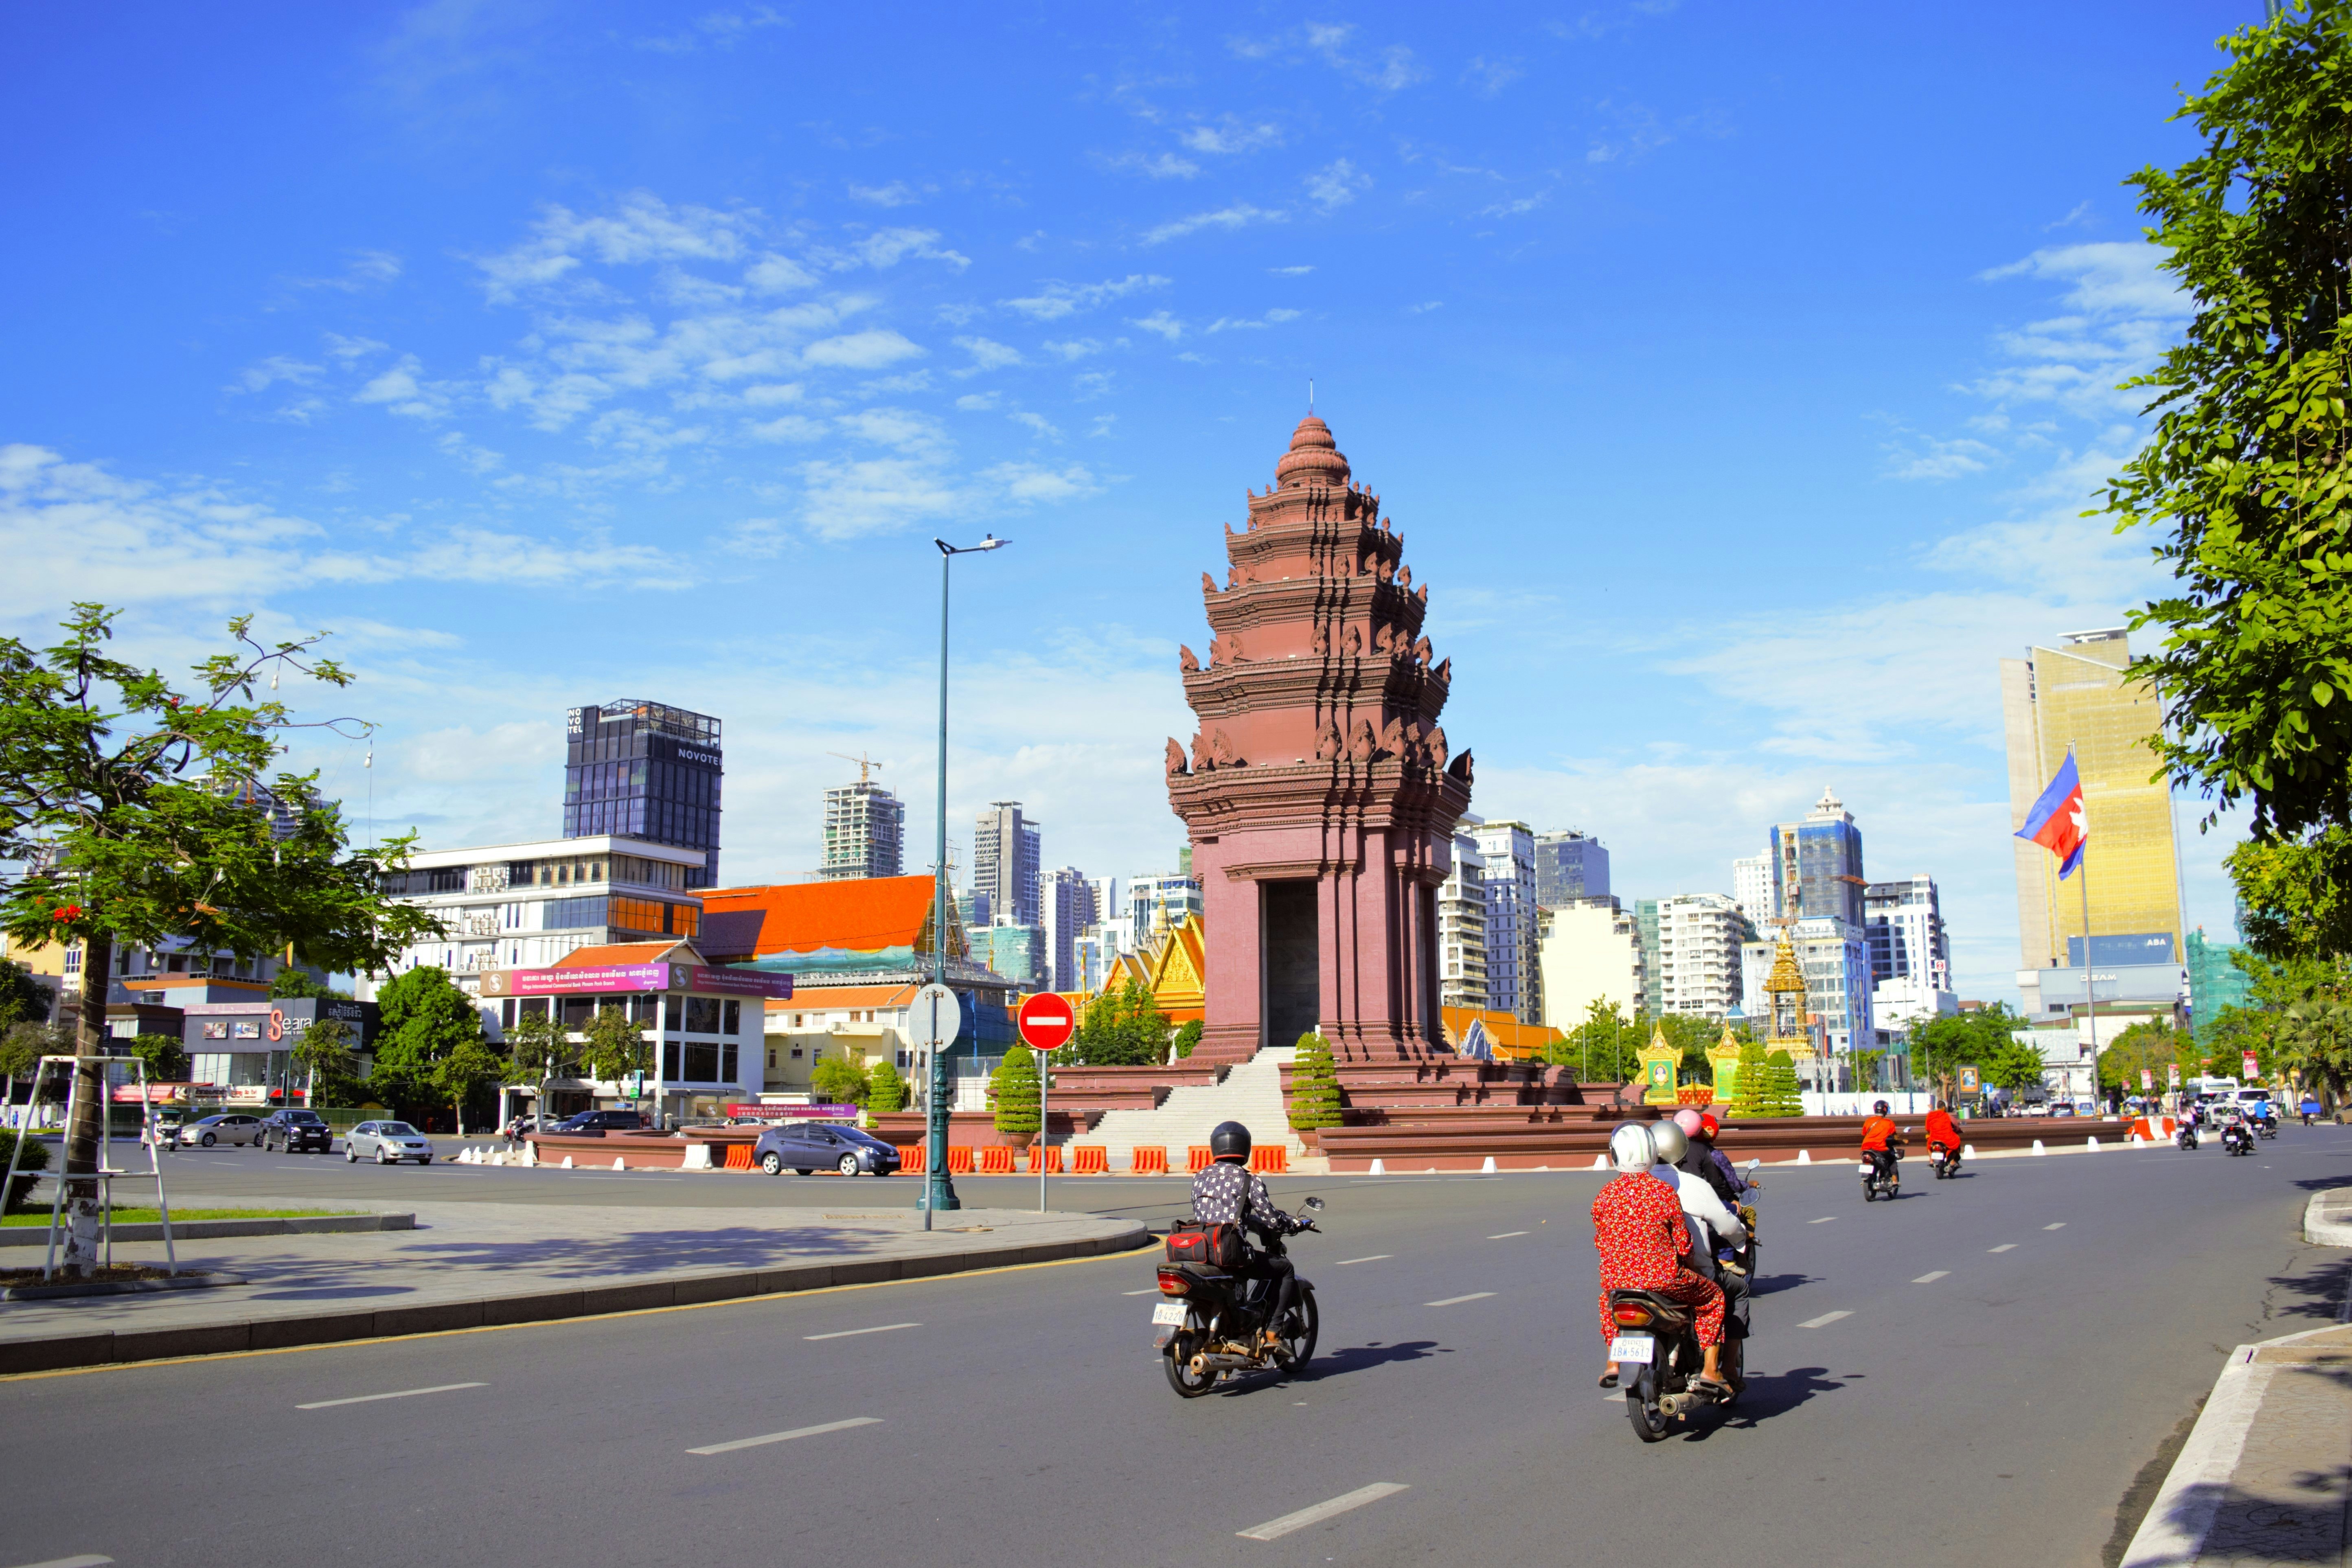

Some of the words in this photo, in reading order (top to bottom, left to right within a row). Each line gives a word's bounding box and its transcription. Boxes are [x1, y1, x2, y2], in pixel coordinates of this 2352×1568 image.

[568, 708, 581, 717] NO
[568, 717, 581, 725] VO
[568, 725, 583, 734] TEL
[678, 748, 723, 766] NOVOTEL
